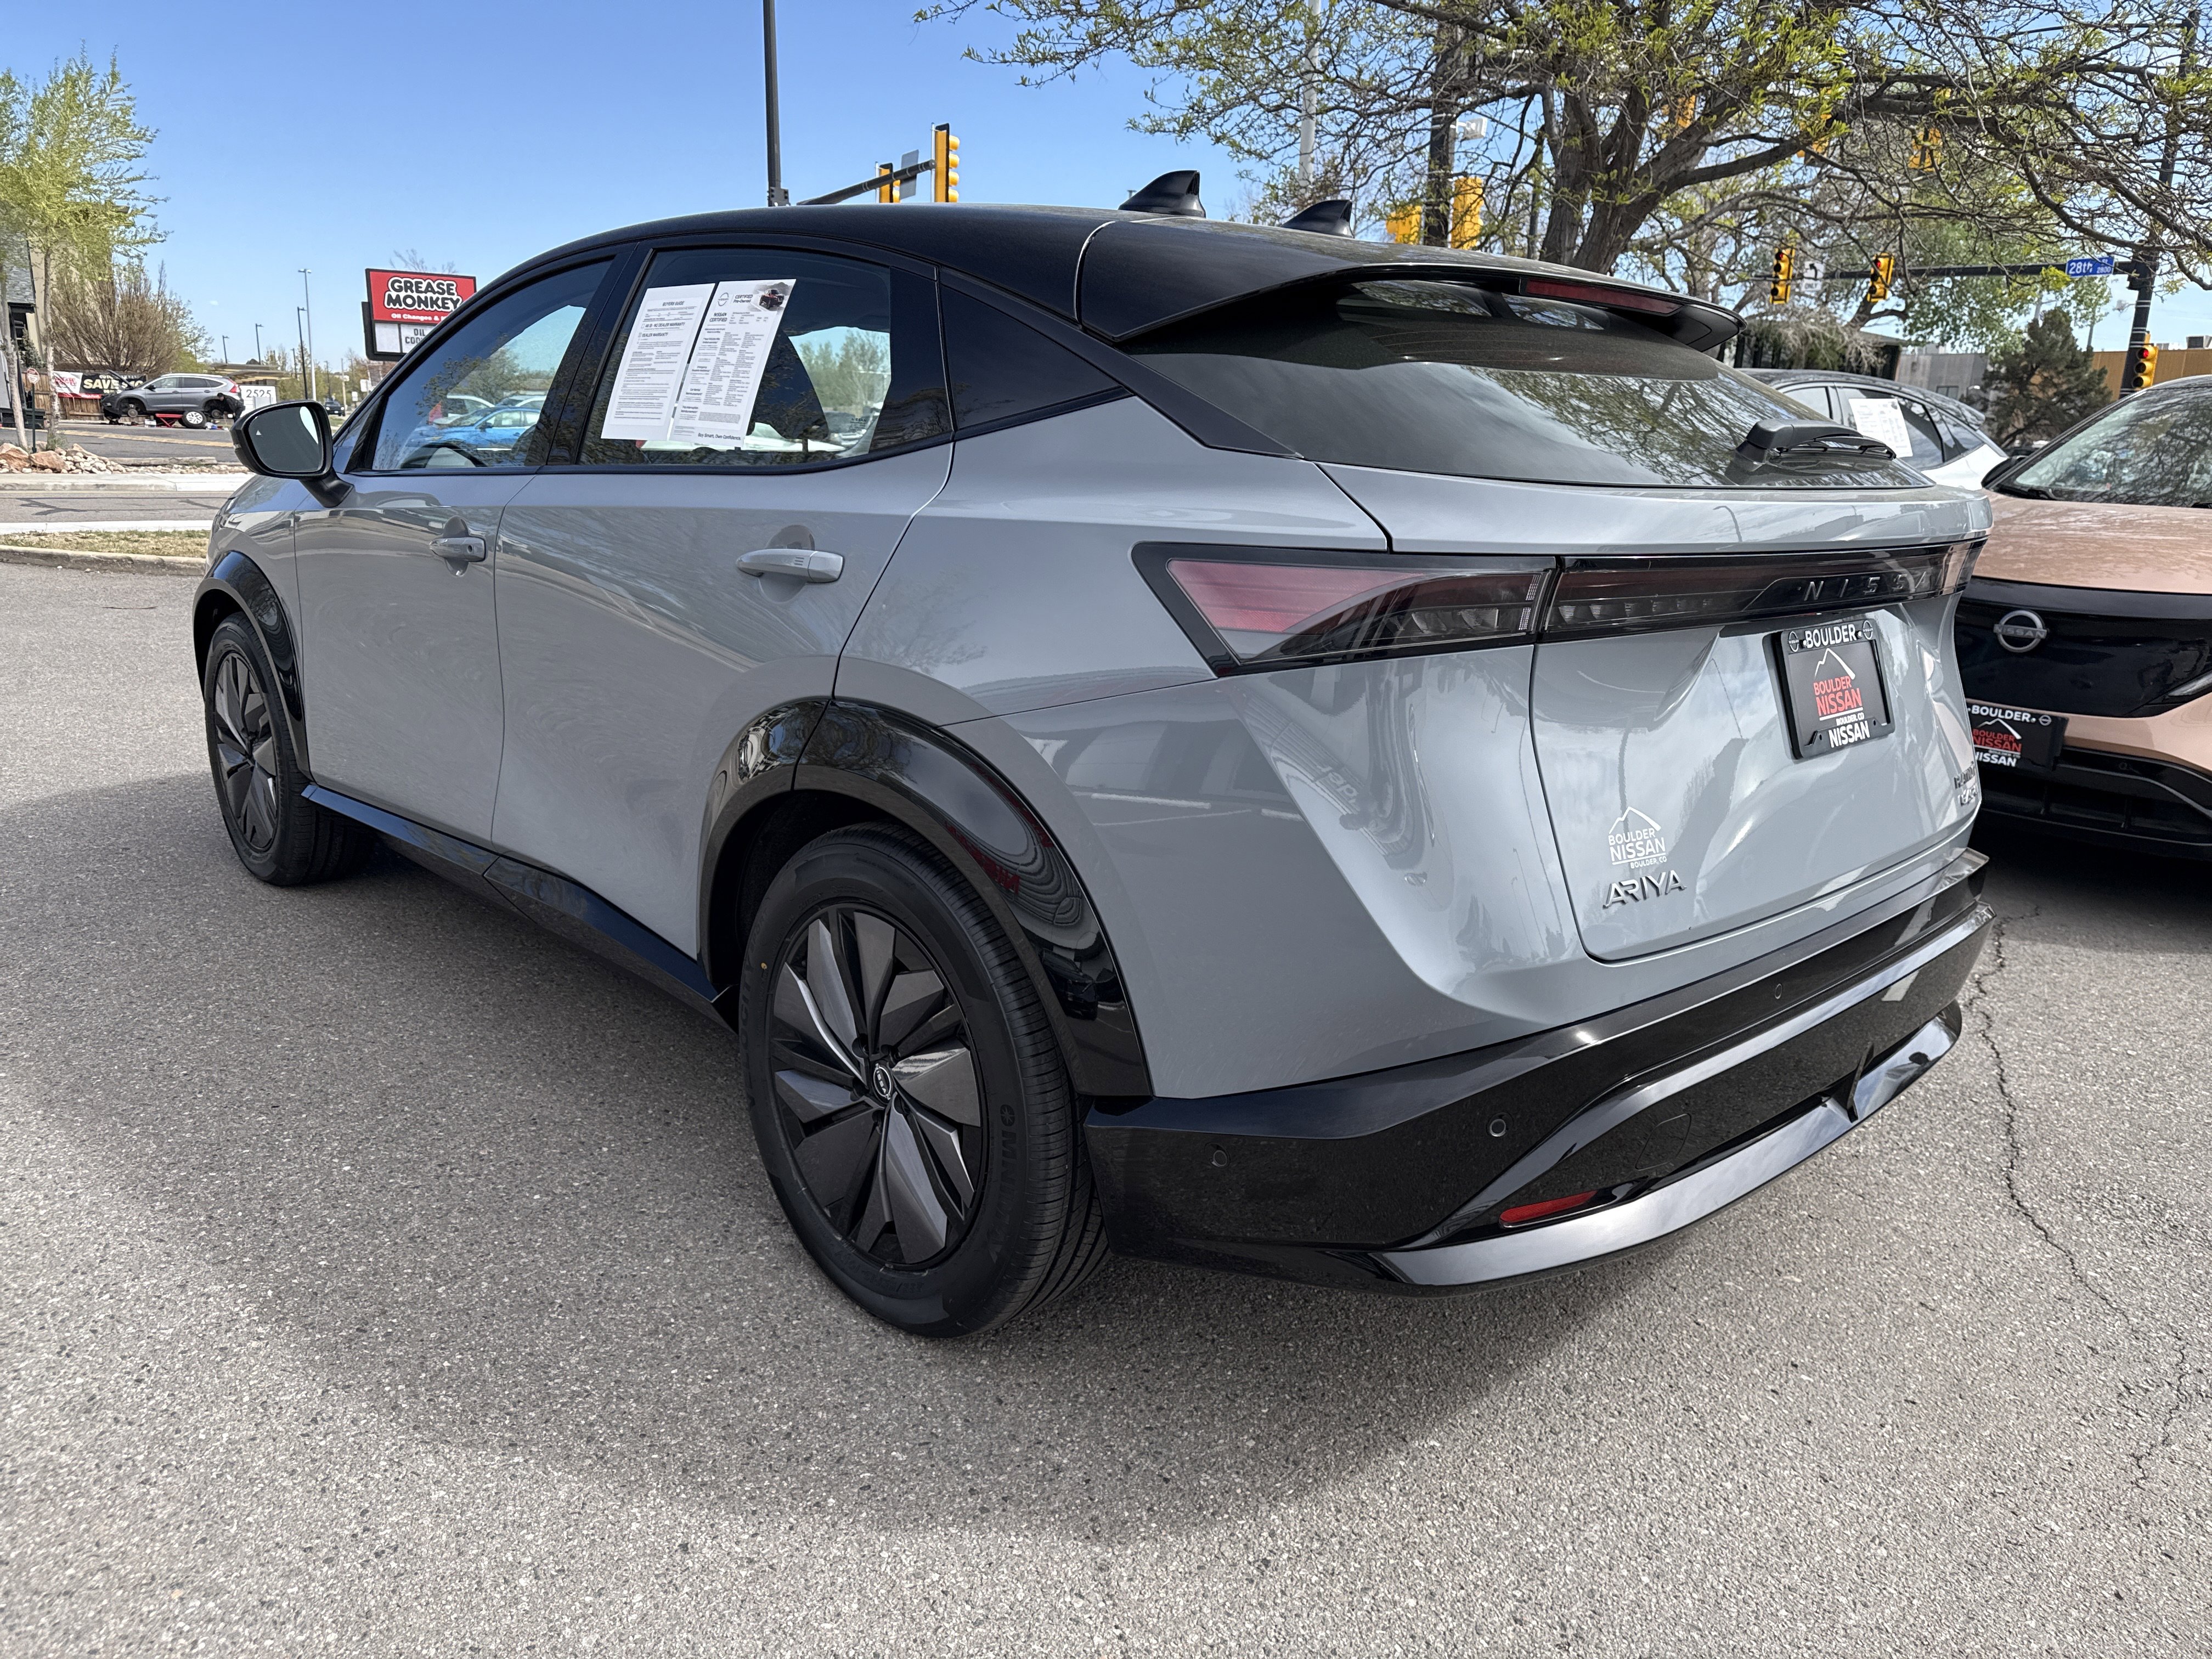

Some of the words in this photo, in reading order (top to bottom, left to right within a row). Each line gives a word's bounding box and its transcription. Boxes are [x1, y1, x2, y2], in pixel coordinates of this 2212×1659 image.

[2069, 262, 2093, 274] 28th
[390, 279, 455, 296] GREASE
[386, 293, 460, 310] MONKEY
[403, 313, 432, 321] Changes
[83, 379, 119, 390] SAVE
[246, 389, 272, 398] 2525
[1805, 624, 1857, 648] BOULDER
[1994, 625, 2046, 638] NISSAN
[1813, 675, 1852, 696] BOULDER
[1816, 688, 1863, 716] NISSAN
[1971, 705, 2031, 723] BOULDER
[1829, 720, 1870, 748] NISSAN
[1973, 729, 2016, 741] BOULDER
[1973, 737, 2022, 752] NISSAN
[1608, 828, 1656, 845] BOULDER
[1610, 837, 1666, 862] NISSAN
[1630, 858, 1658, 869] BOULDER,
[1602, 870, 1686, 909] ARIYA
